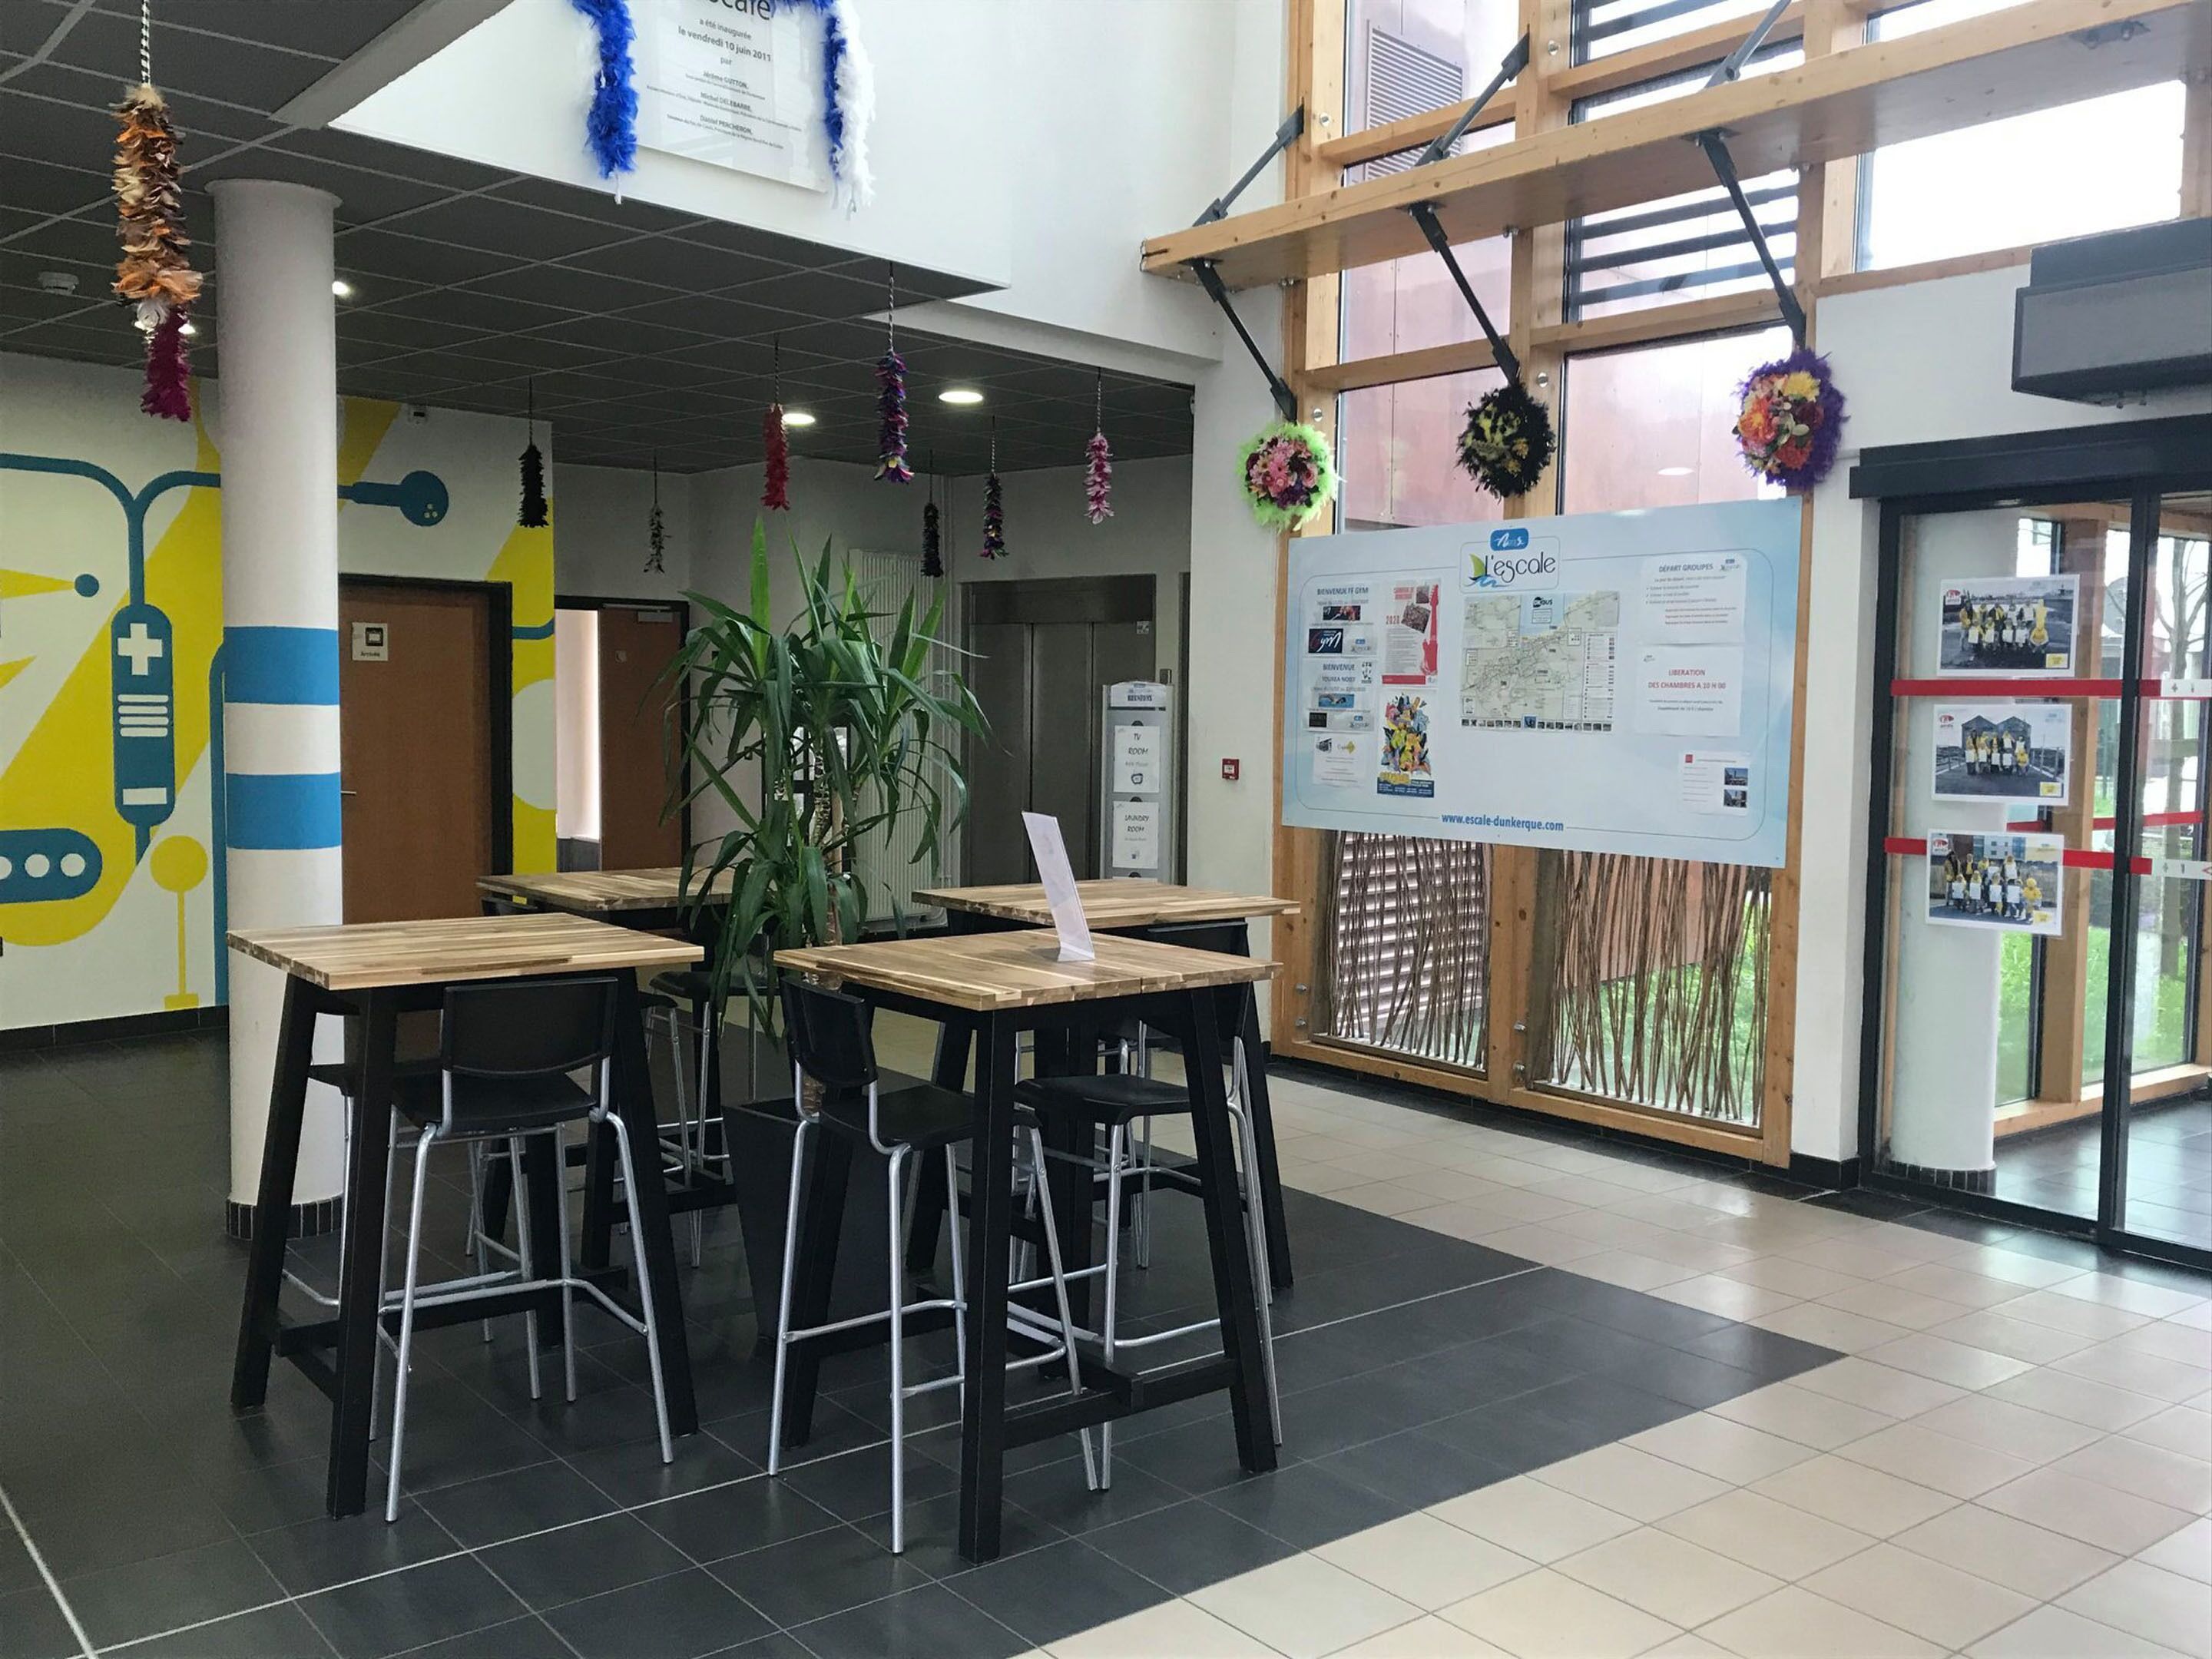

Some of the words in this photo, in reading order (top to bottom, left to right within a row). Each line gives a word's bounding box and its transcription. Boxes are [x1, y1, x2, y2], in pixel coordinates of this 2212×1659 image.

[705, 19, 717, 29] été
[717, 25, 752, 41] inaugurée
[677, 25, 687, 35] le
[687, 31, 724, 48] vendredi
[725, 41, 735, 51] 10
[735, 45, 751, 56] juin
[753, 49, 771, 62] 2011
[720, 57, 733, 65] par
[1667, 668, 1707, 677] LIBERATION
[1647, 681, 1660, 690] DES
[1660, 681, 1696, 690] CHAMBRES
[1696, 681, 1702, 690] A
[1133, 732, 1142, 741] TV
[1128, 747, 1149, 756] ROOM
[1441, 813, 1565, 833] www.escale-dunkerque.com
